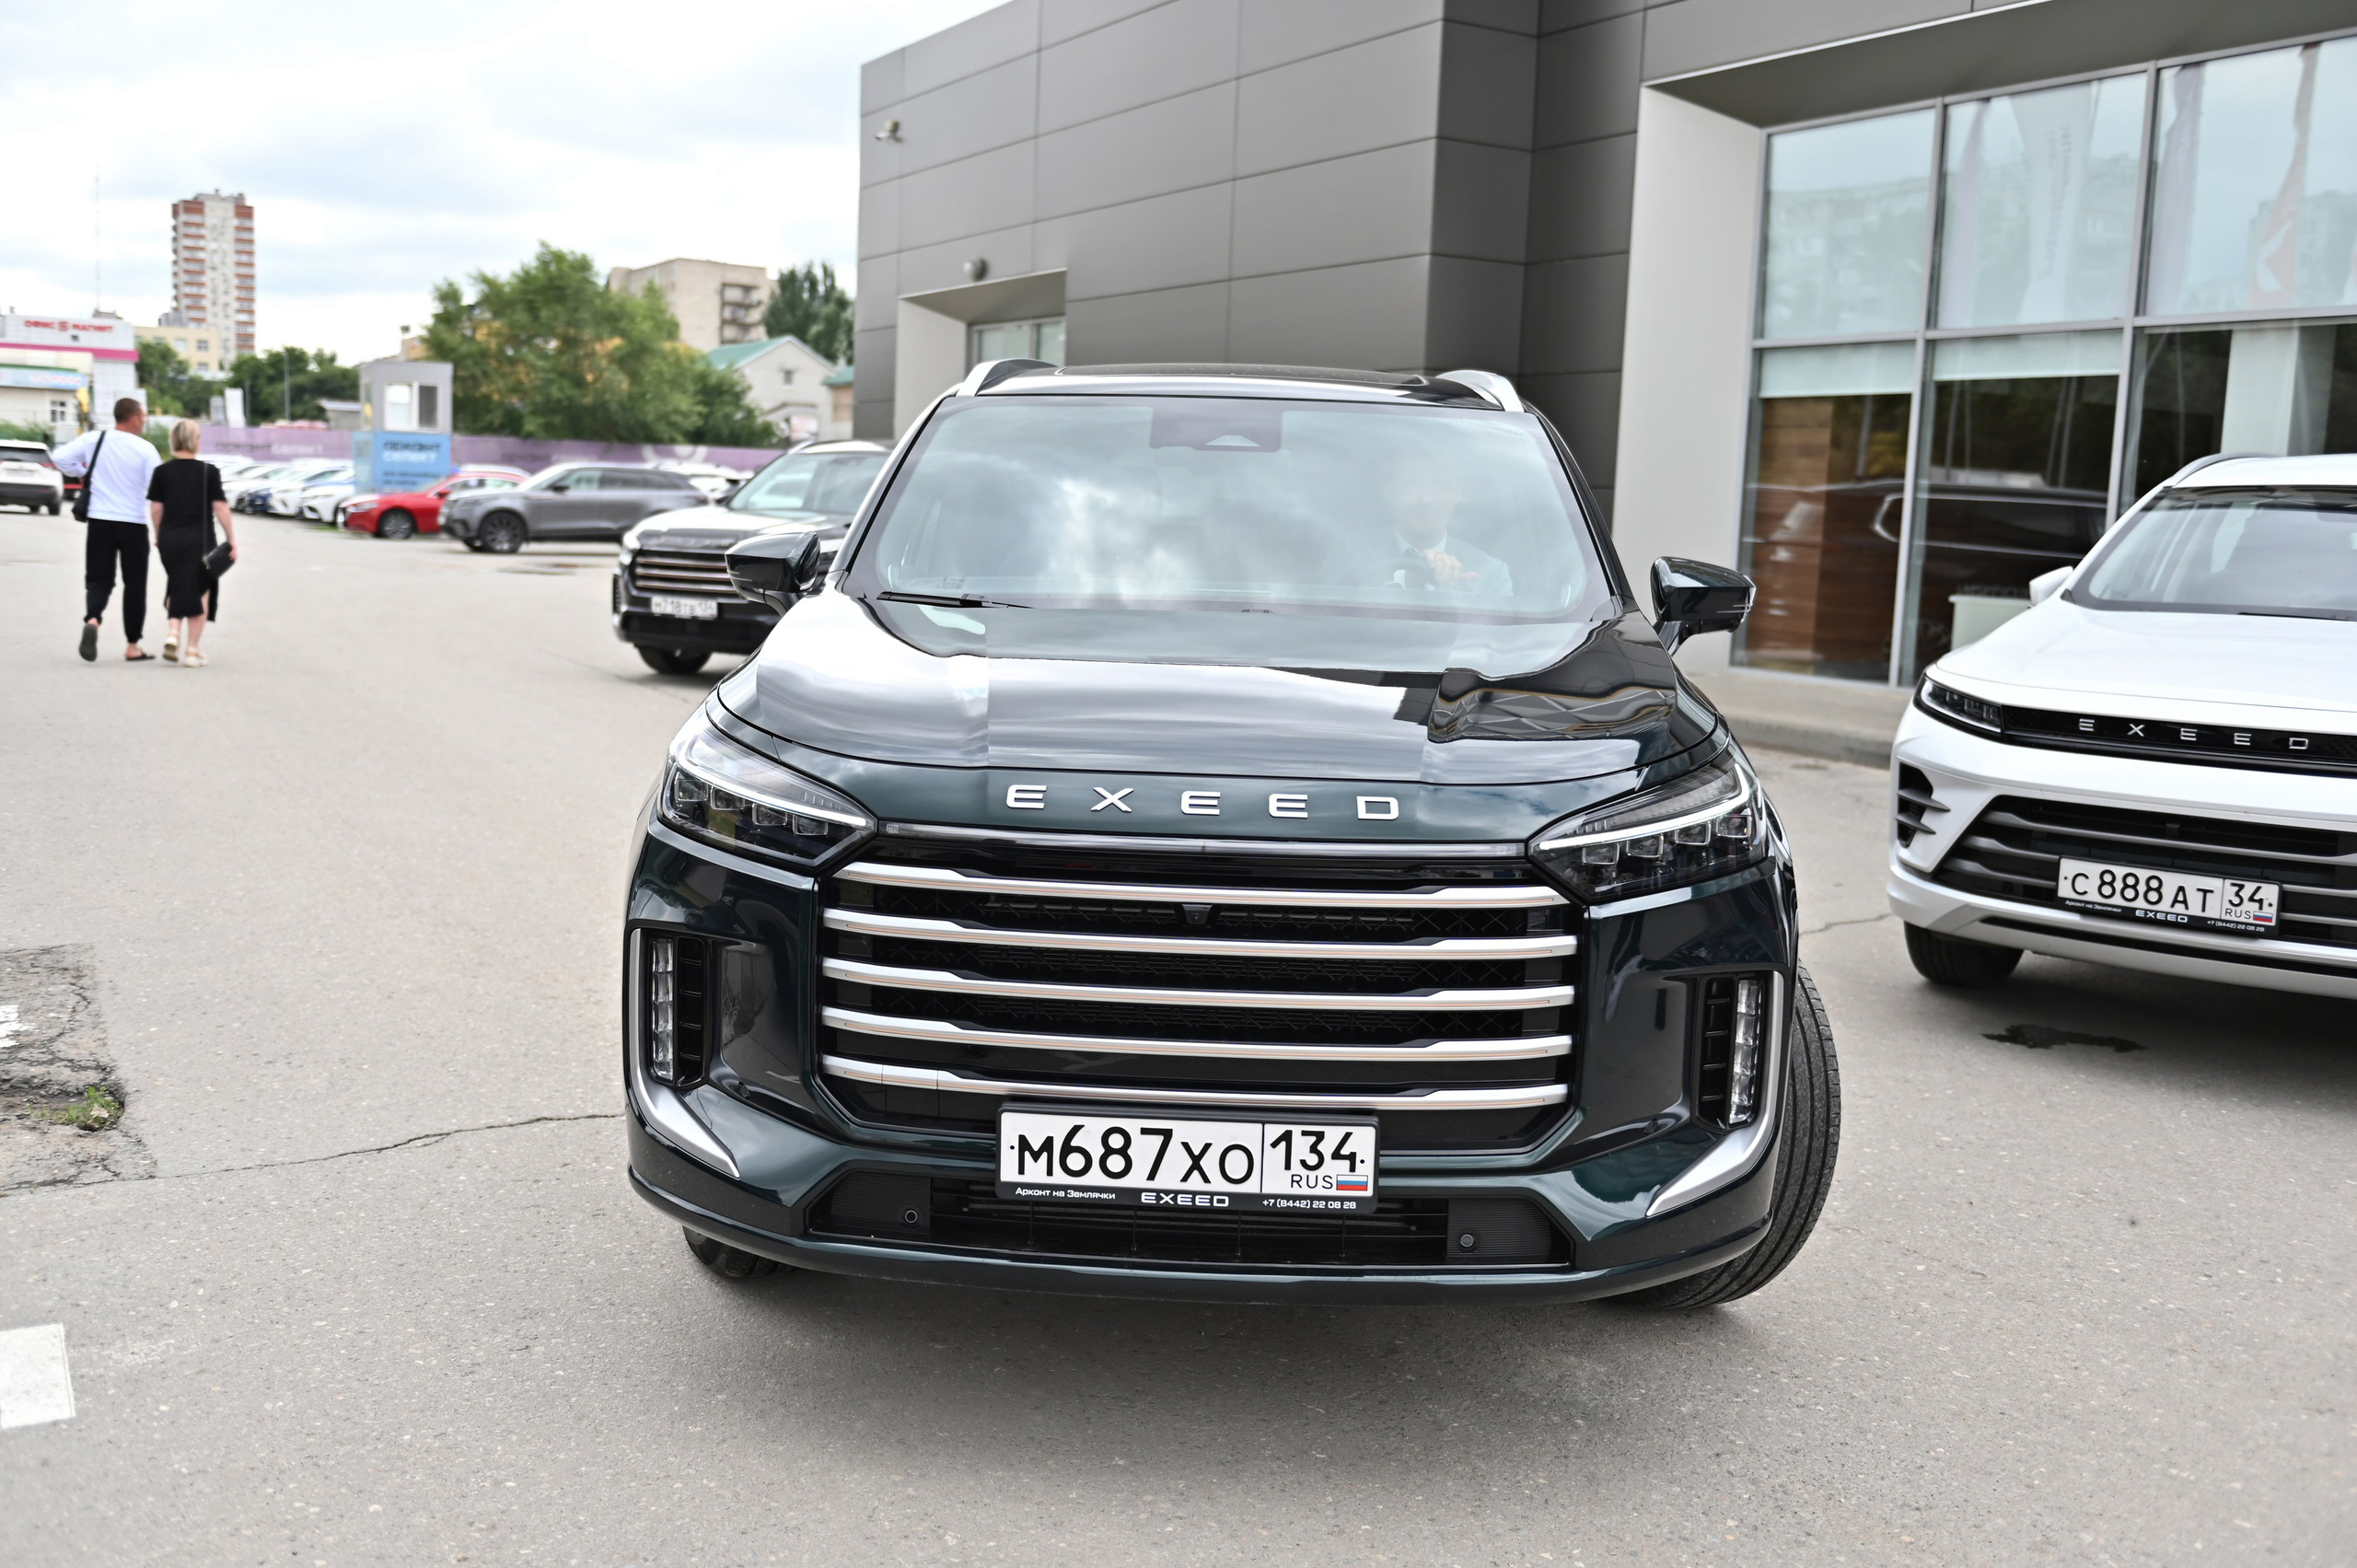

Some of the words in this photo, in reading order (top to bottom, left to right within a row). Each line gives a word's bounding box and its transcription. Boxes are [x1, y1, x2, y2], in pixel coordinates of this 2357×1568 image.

[2079, 718, 2309, 750] EXEED
[1005, 784, 1399, 820] EXEED
[2072, 869, 2214, 913] С888АТ
[2228, 882, 2265, 911] 34
[2135, 909, 2188, 923] EXEED
[2224, 908, 2252, 920] RUS
[1017, 1124, 1255, 1185] М687ХО
[1270, 1129, 1356, 1173] 134
[1290, 1174, 1334, 1191] RUS
[1016, 1187, 1051, 1196] Арконт
[1067, 1190, 1116, 1200] Землячки
[1141, 1191, 1229, 1207] EXEED
[1262, 1199, 1275, 1207] +7
[1276, 1200, 1310, 1209] (8442)
[1312, 1201, 1326, 1209] 22
[1328, 1202, 1341, 1210] 08
[1342, 1202, 1357, 1210] 28
